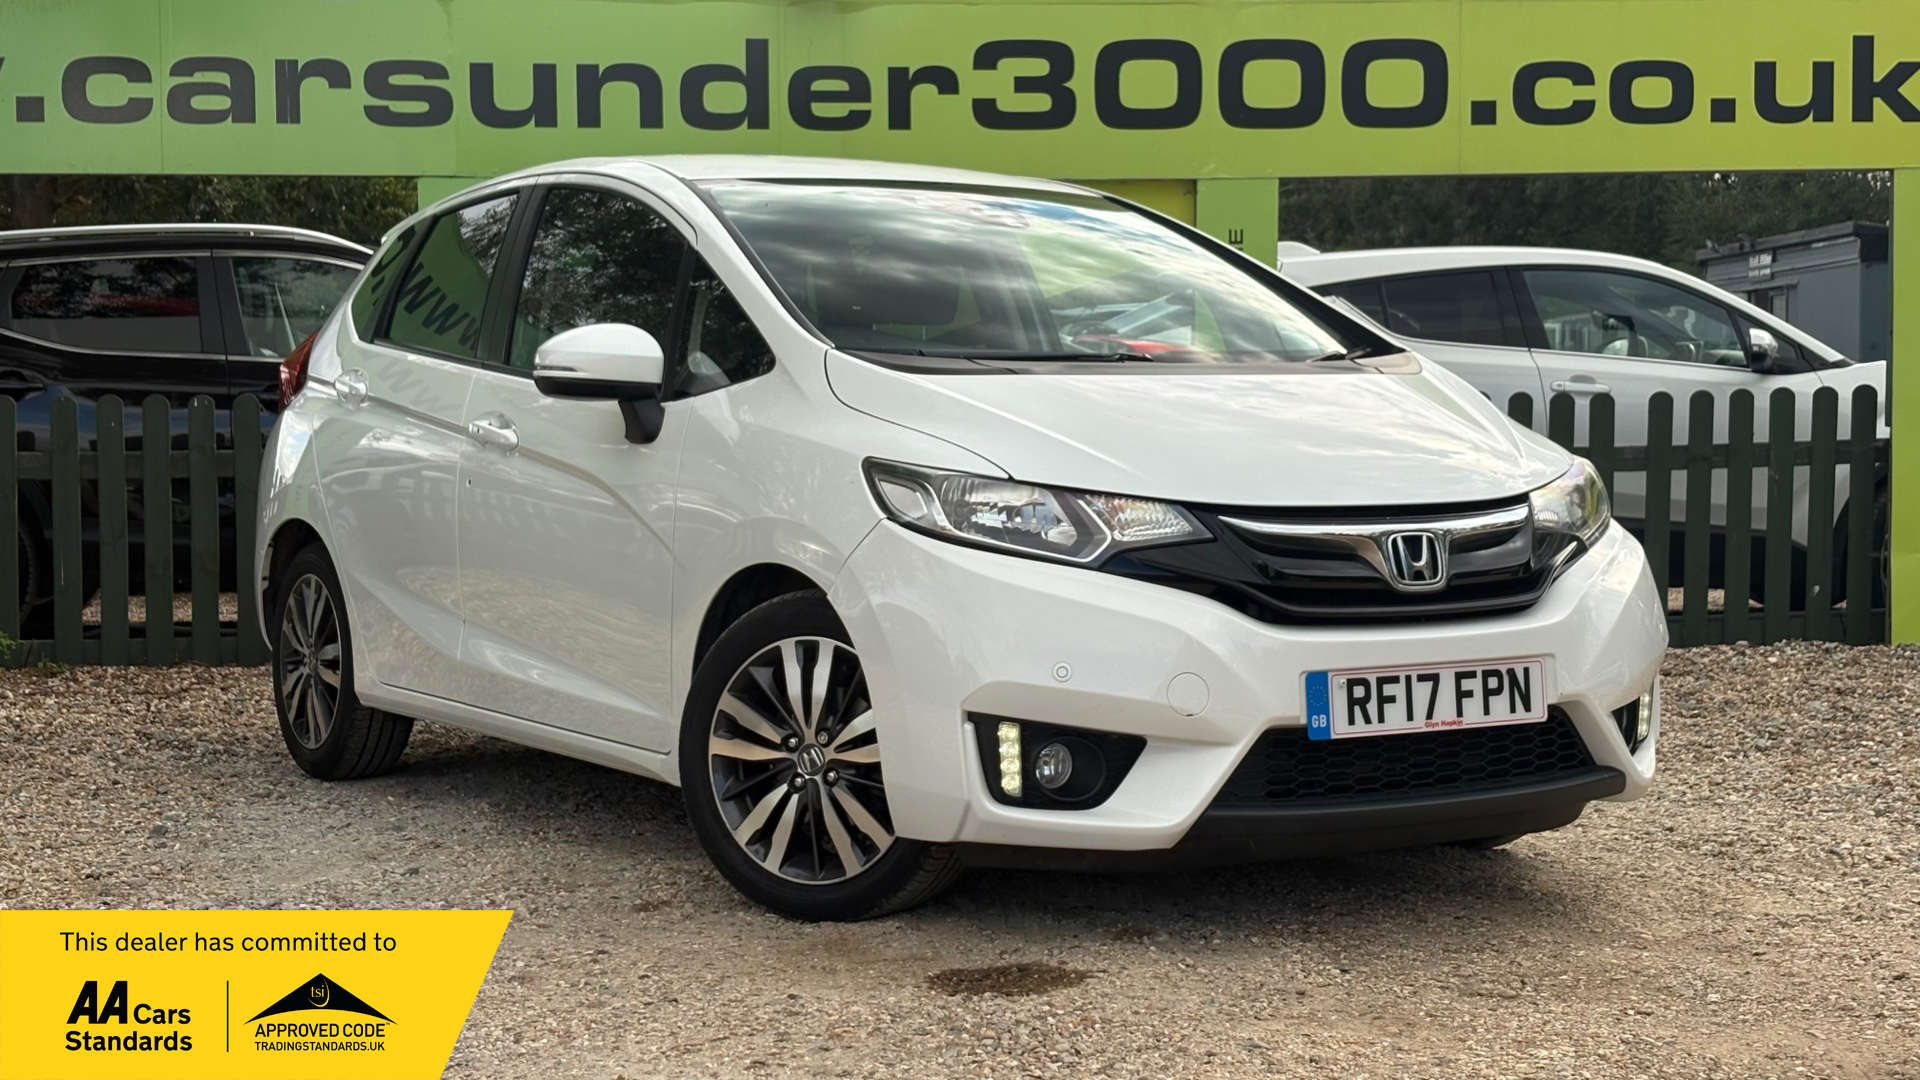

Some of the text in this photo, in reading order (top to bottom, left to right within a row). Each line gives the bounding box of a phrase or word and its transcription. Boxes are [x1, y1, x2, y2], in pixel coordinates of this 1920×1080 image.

[0, 36, 1920, 131] .carsunder3000.co.uk
[1311, 714, 1328, 728] GB
[1346, 667, 1532, 726] RF17 FPN
